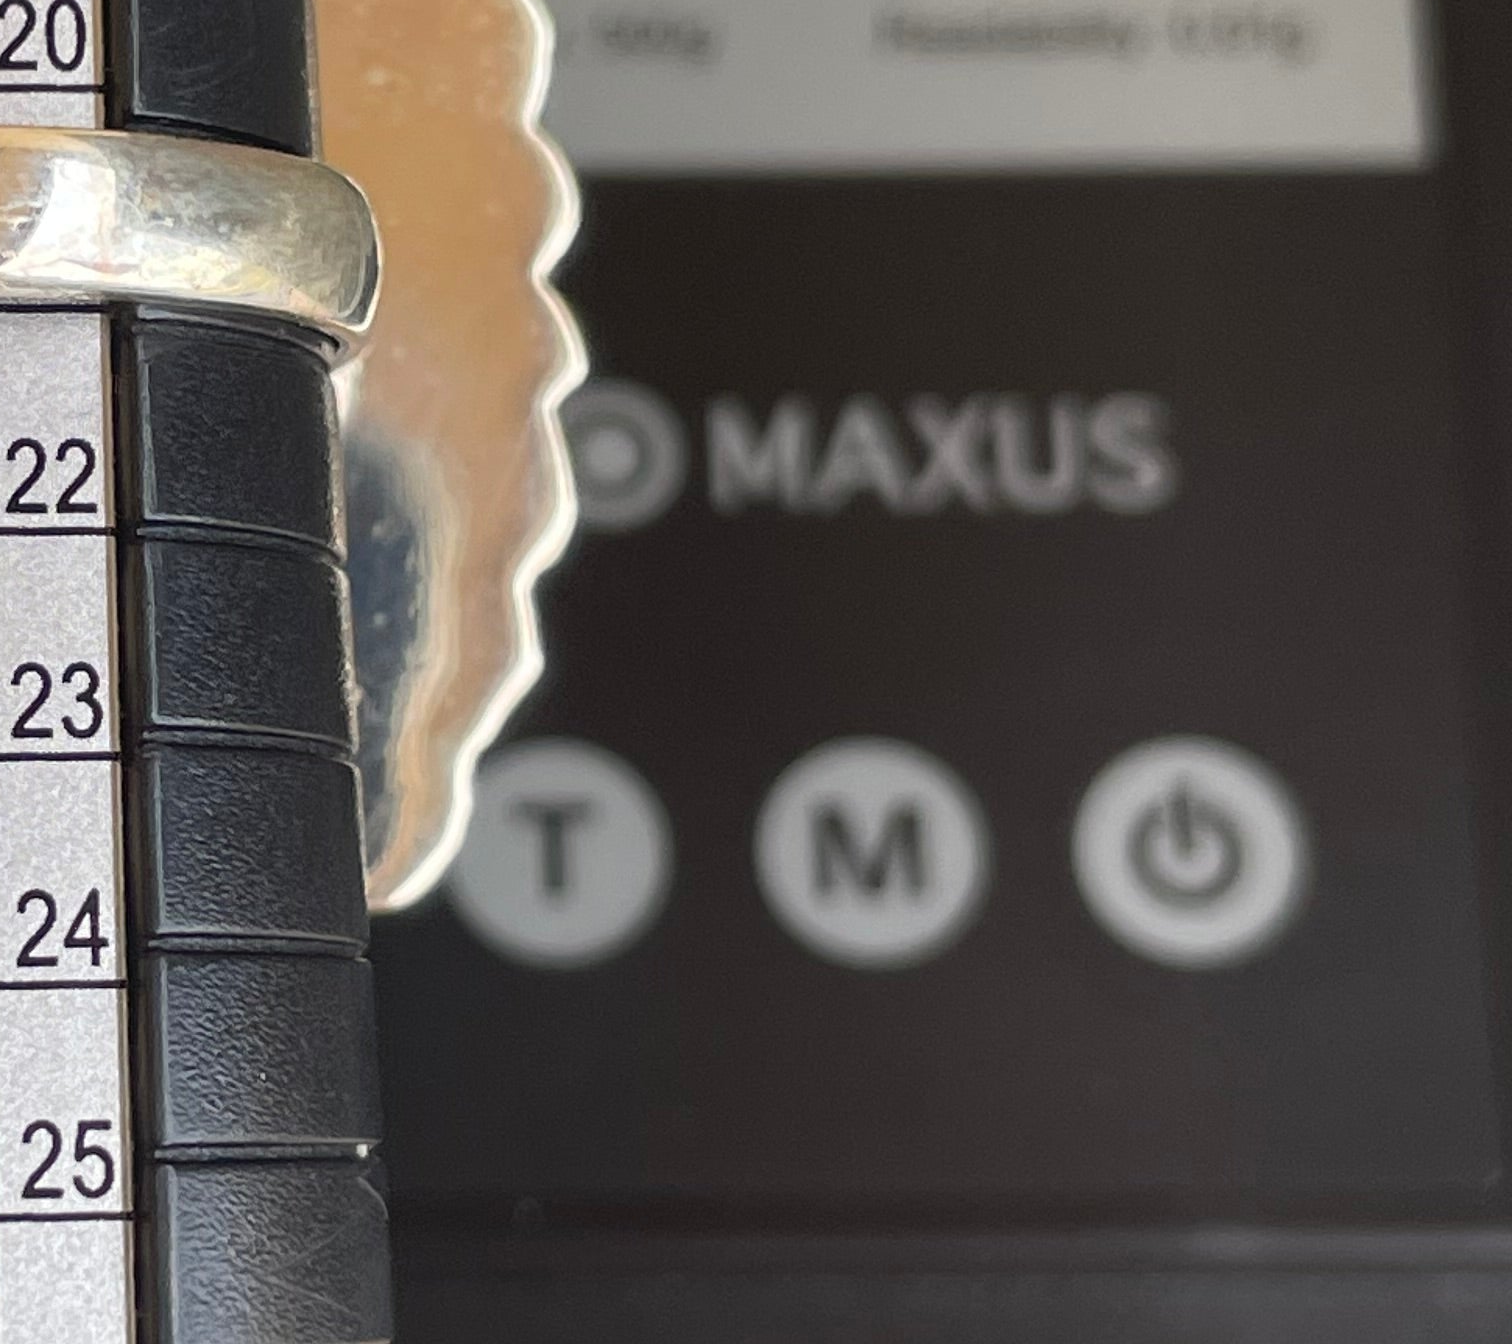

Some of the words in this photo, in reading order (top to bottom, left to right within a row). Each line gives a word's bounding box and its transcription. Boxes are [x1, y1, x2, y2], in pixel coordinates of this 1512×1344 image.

[4, 436, 99, 515] 22
[703, 391, 1173, 516] MAXUS
[9, 660, 105, 740] 23
[512, 796, 591, 901] T
[808, 794, 926, 903] M
[15, 887, 110, 969] 24
[20, 1119, 115, 1200] 25
